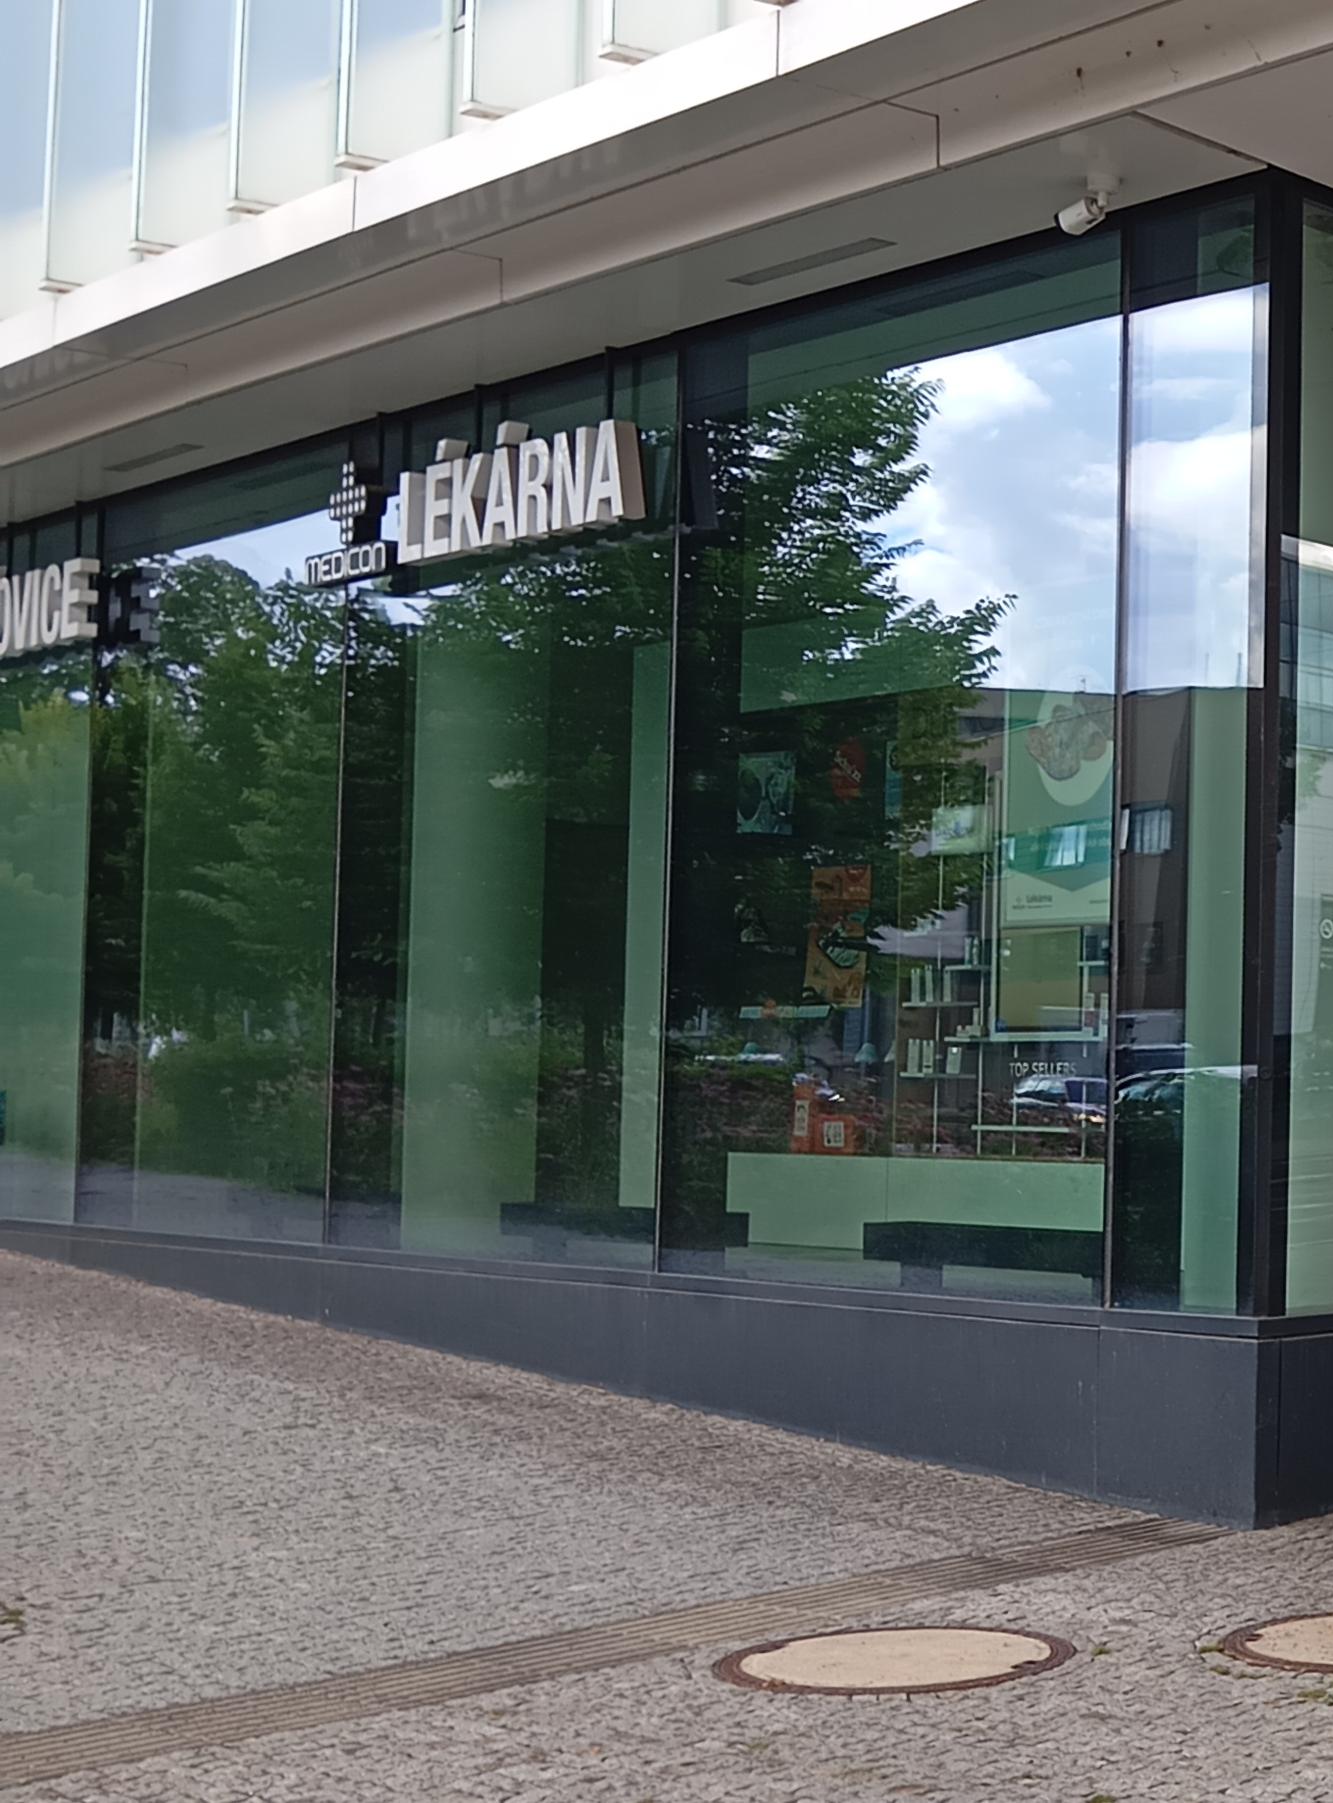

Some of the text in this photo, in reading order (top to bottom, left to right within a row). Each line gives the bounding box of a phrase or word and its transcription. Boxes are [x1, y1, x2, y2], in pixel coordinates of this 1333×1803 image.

[397, 419, 640, 564] LÉKÁRNA
[305, 542, 386, 585] MEDICON
[1009, 1062, 1076, 1077] TOP SELLERS
